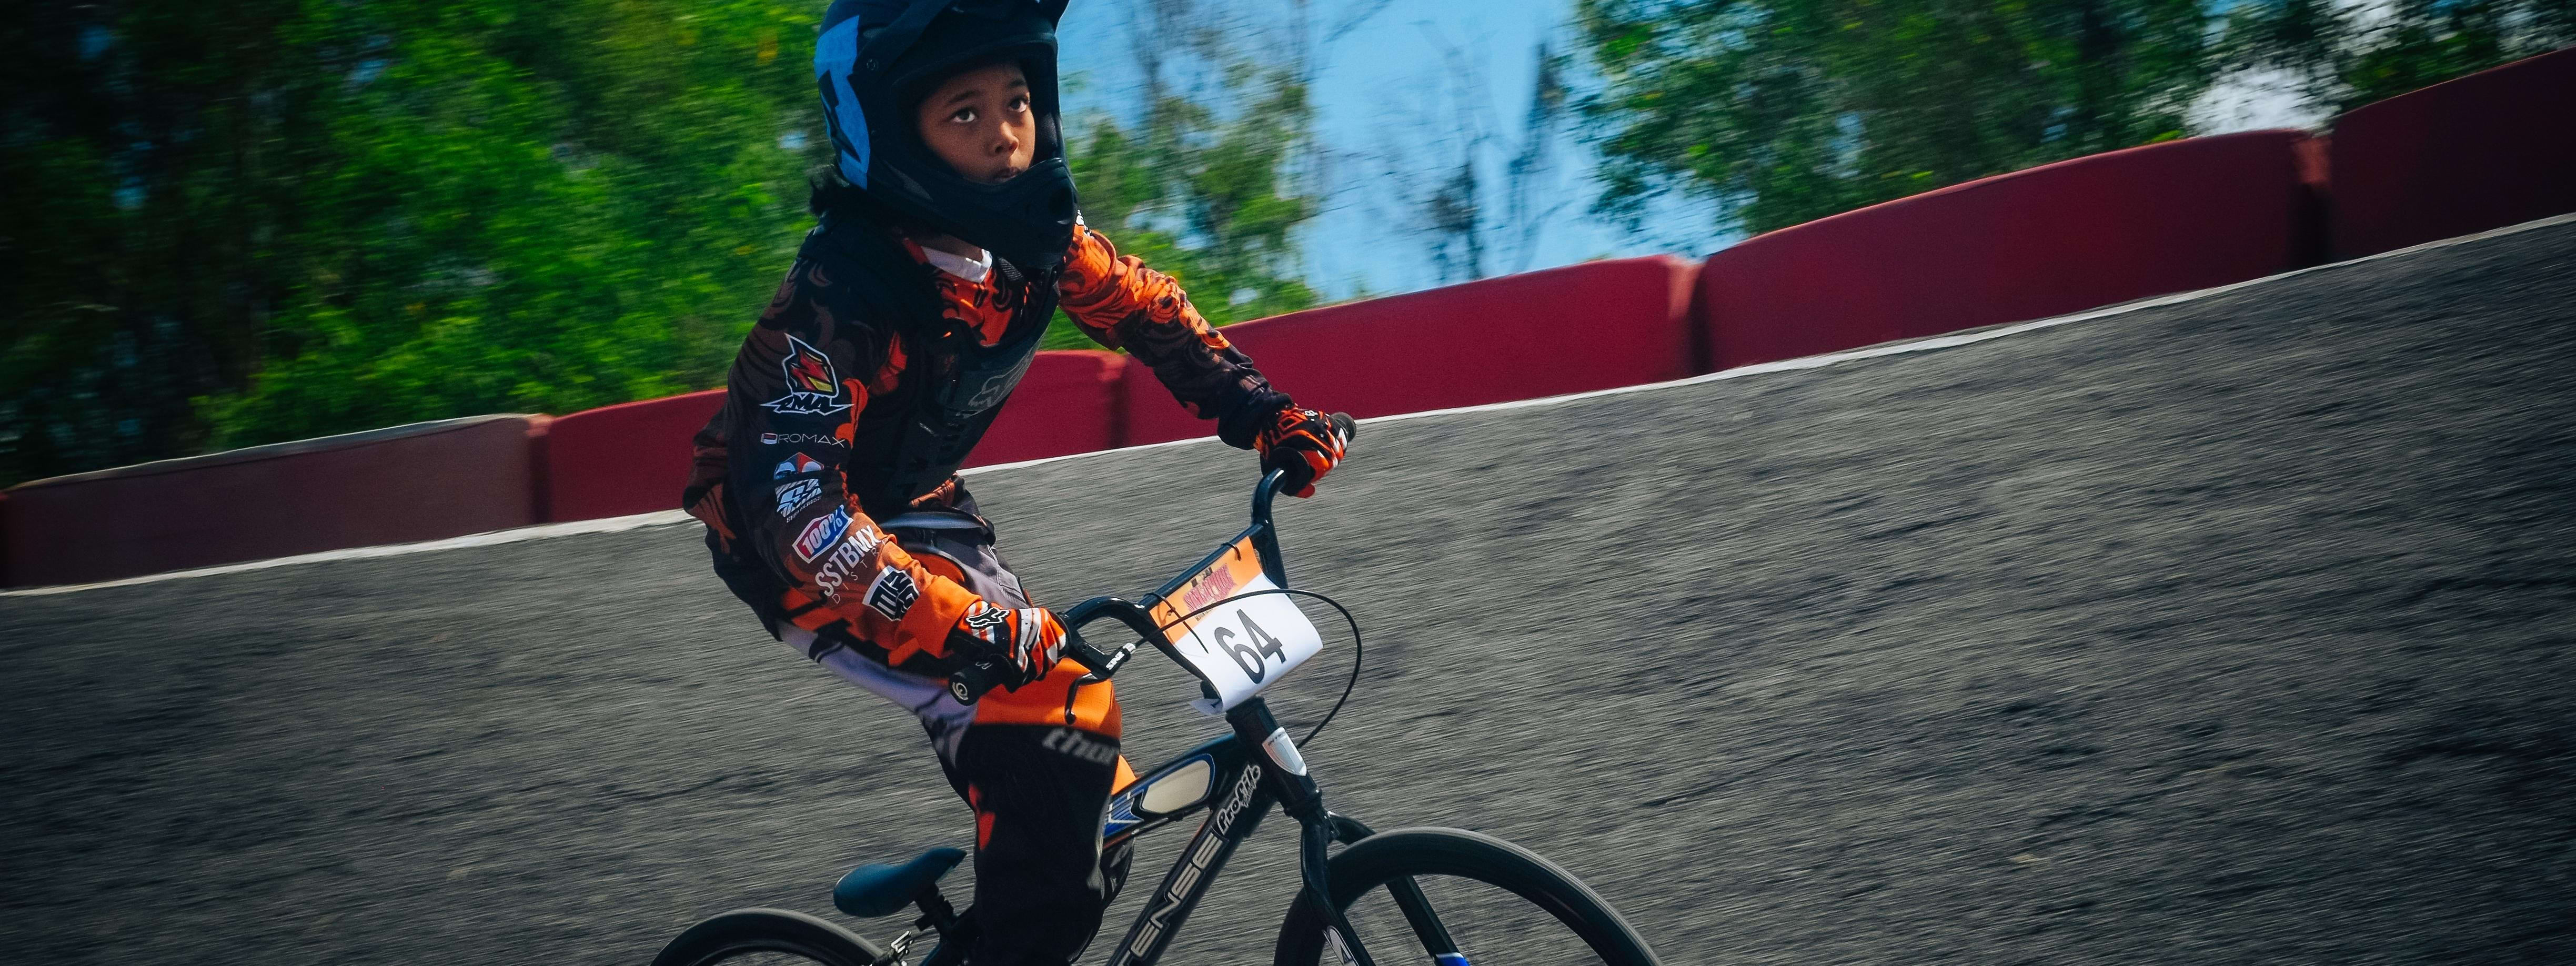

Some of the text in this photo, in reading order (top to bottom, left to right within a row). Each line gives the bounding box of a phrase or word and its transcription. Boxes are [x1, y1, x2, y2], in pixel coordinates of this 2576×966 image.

[802, 509, 843, 555] 100%
[815, 525, 882, 597] SSTBMX
[1105, 651, 1125, 670] SINZ
[1214, 609, 1286, 685] 64
